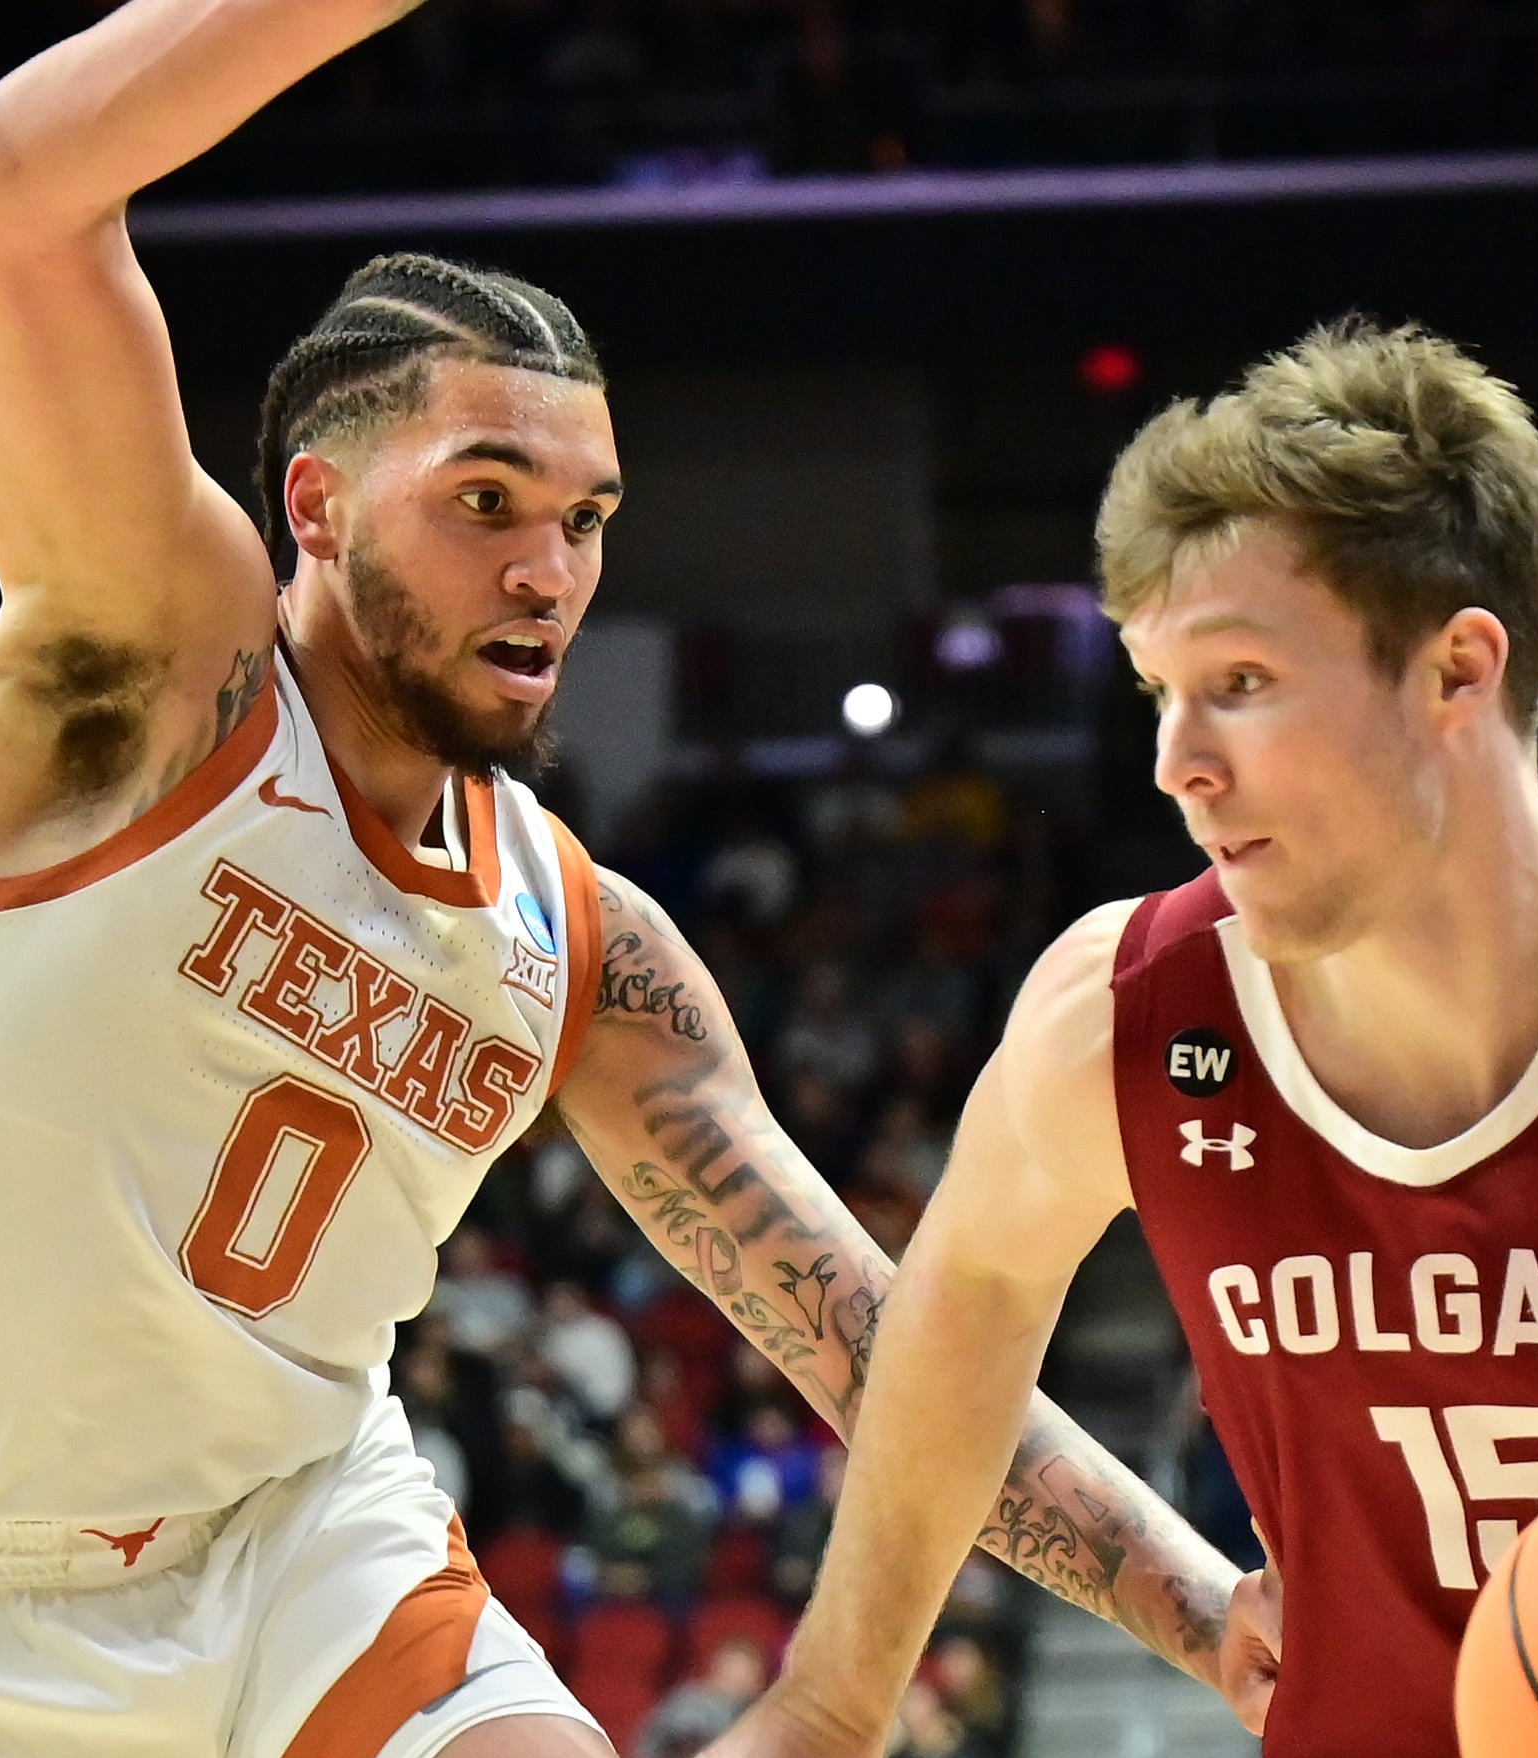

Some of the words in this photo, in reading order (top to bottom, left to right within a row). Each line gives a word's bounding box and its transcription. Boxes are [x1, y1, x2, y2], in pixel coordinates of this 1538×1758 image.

[179, 857, 543, 1156] TEXAS
[1169, 1043, 1232, 1083] EW
[178, 1075, 373, 1322] 0
